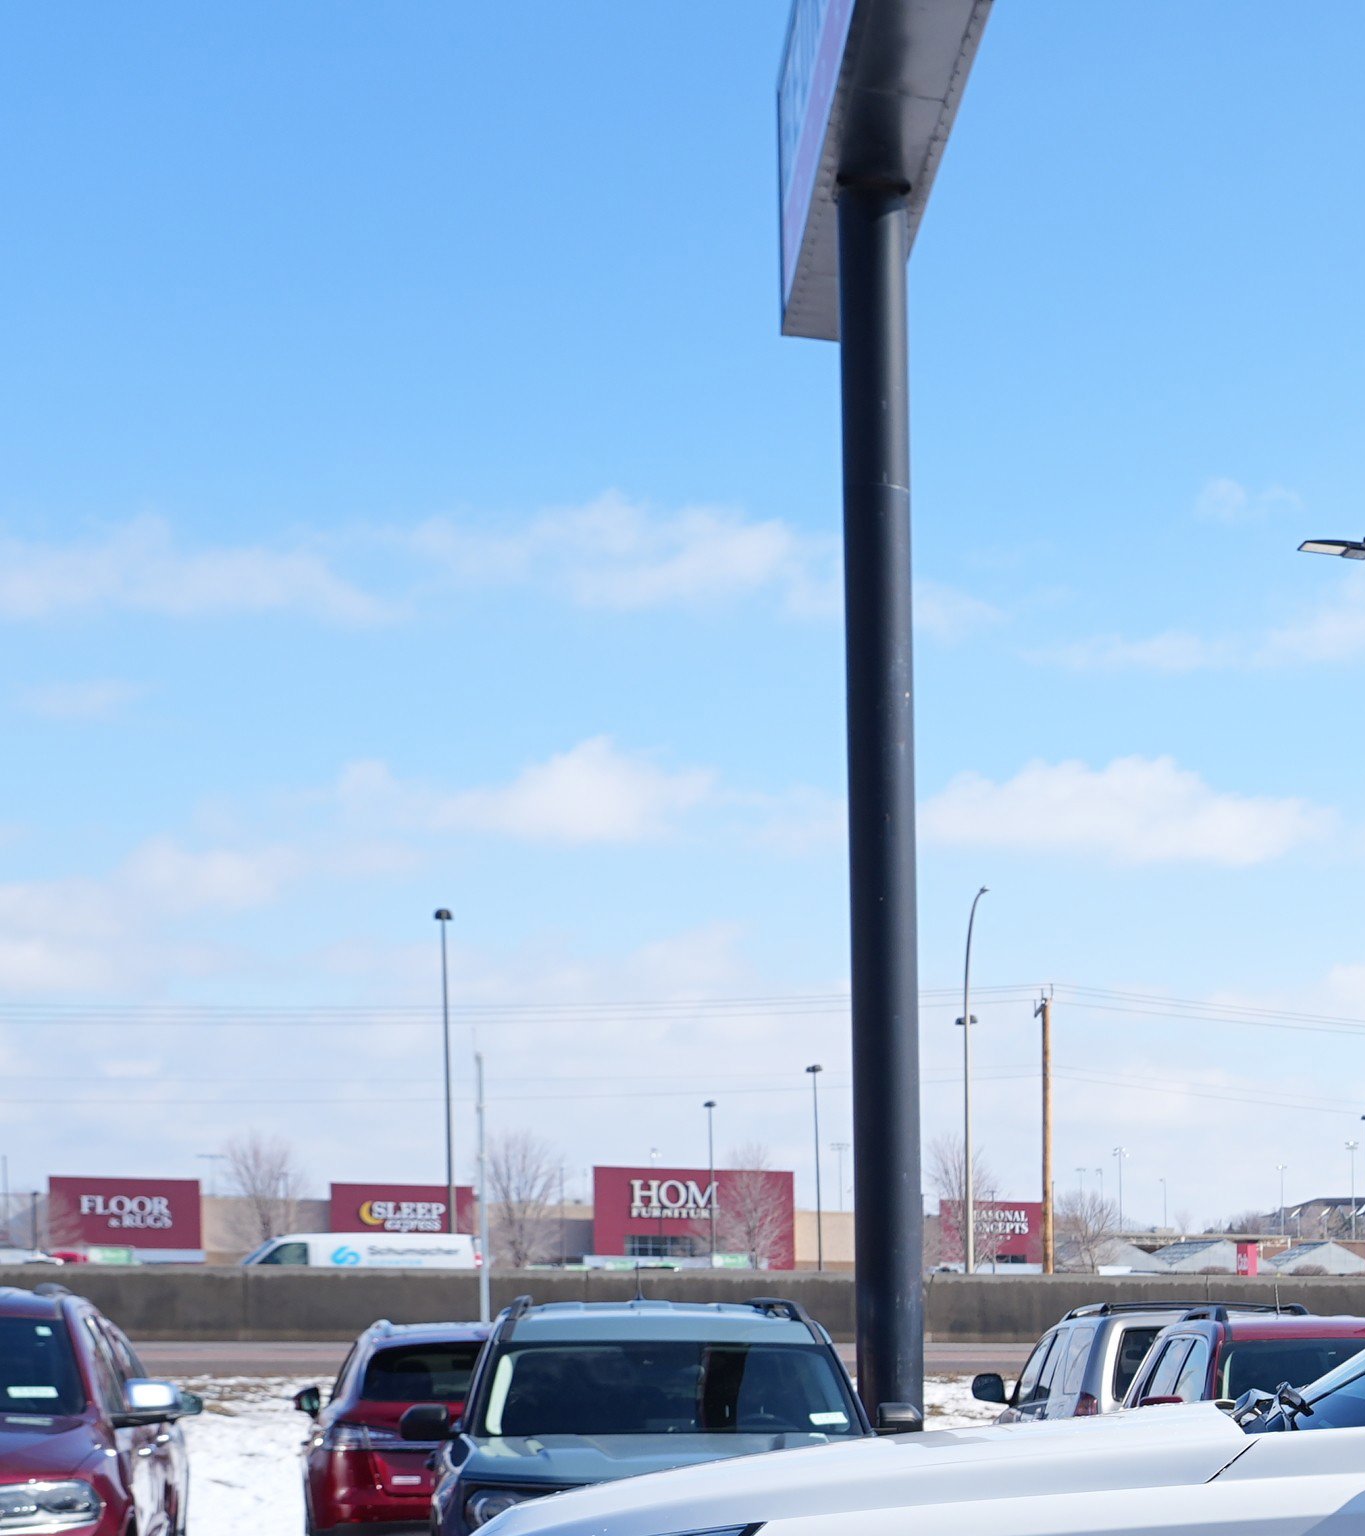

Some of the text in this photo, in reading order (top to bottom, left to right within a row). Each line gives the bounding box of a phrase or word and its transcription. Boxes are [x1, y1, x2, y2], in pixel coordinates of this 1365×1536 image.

[630, 1179, 719, 1208] HOM
[80, 1195, 171, 1217] FLOOR
[371, 1201, 446, 1220] SLEEP
[631, 1207, 719, 1219] FURNITUR
[973, 1210, 1028, 1222] EASONAL
[122, 1214, 172, 1228] RUGS
[384, 1219, 441, 1232] express
[974, 1221, 1029, 1234] ONCEPTS
